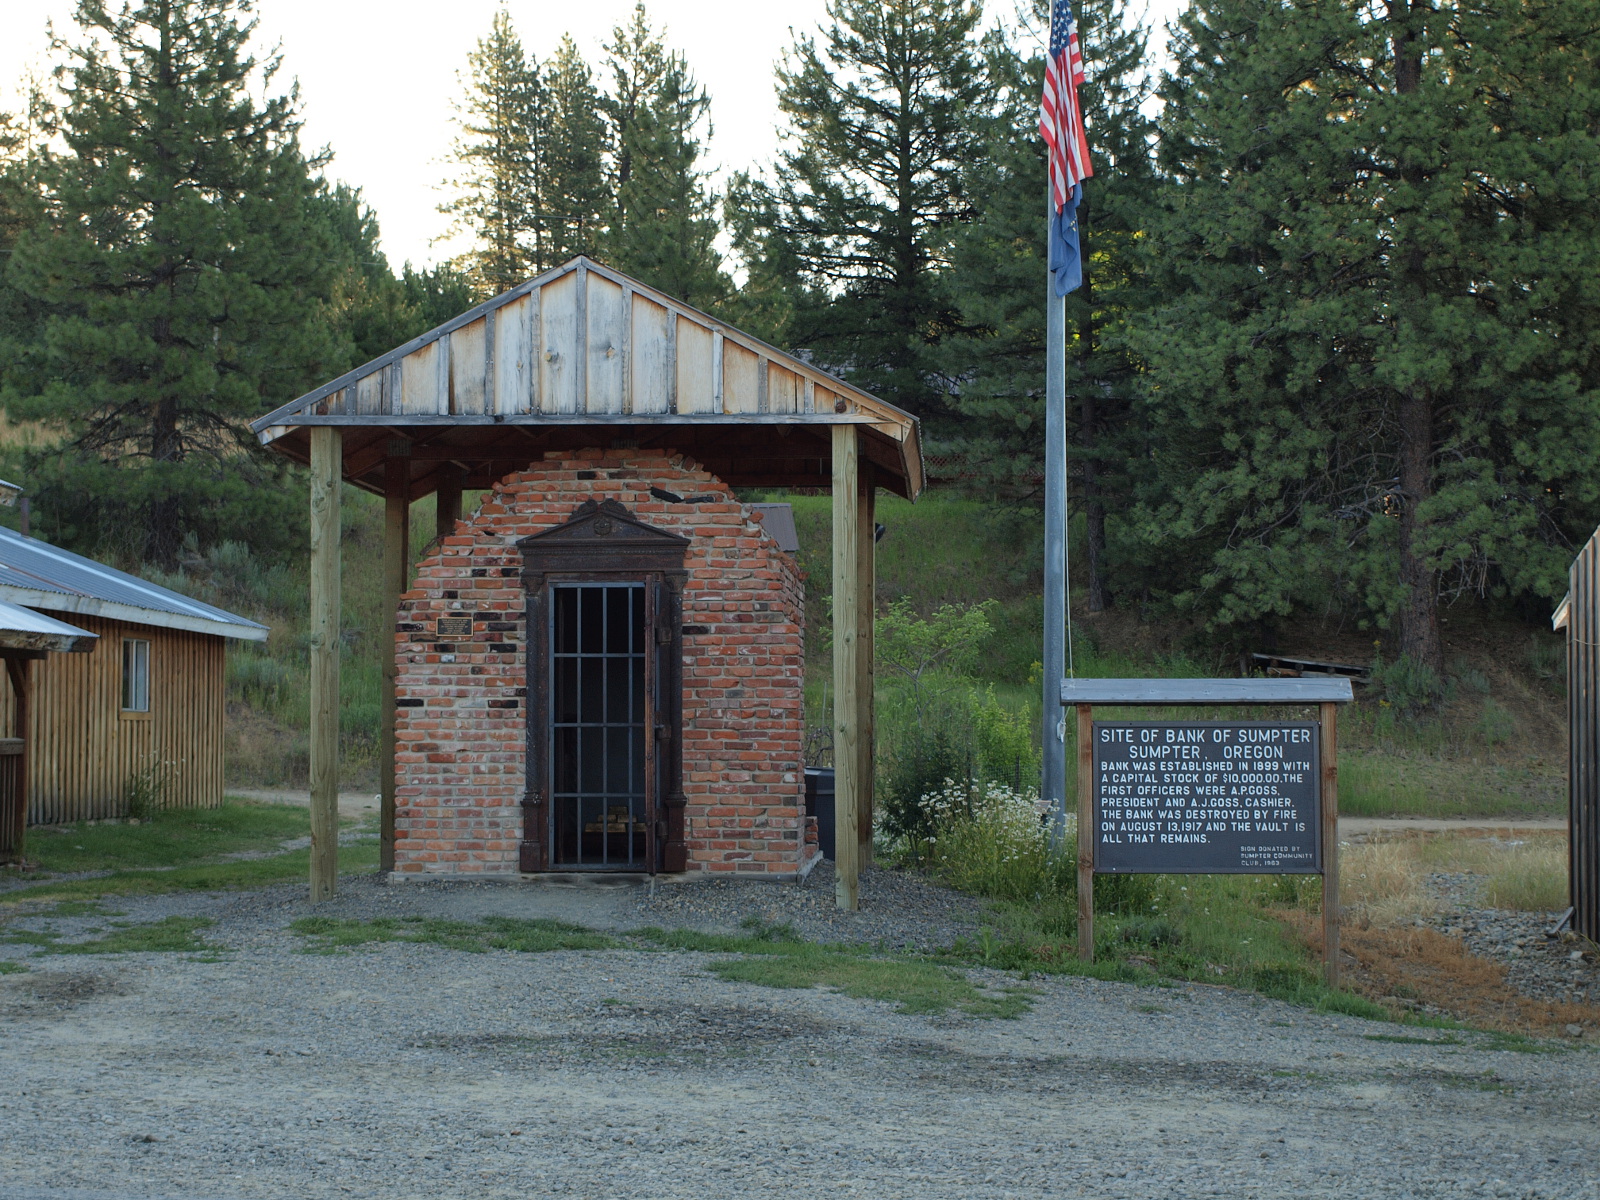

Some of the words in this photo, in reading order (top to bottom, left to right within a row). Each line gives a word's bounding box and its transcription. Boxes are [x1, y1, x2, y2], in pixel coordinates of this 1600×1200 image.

[1100, 728, 1135, 743] SITE
[1140, 728, 1160, 743] OF
[1165, 728, 1206, 743] BANK
[1212, 728, 1232, 743] OF
[1238, 728, 1311, 743] SUMPTER
[1223, 744, 1283, 758] OREGON
[1100, 760, 1130, 771] BANK
[1132, 760, 1156, 771] WAS
[1159, 760, 1234, 771] ESTABLISHED
[1238, 760, 1249, 771] IN
[1253, 760, 1279, 771] 1899
[1282, 760, 1310, 771] WITH
[1101, 772, 1109, 783] A
[1112, 772, 1159, 783] CAPITAL
[1163, 772, 1199, 783] STOCK
[1204, 772, 1219, 783] OF
[1101, 784, 1133, 795] FIRST
[1137, 784, 1191, 795] OFFICERS
[1195, 784, 1226, 795] WERE
[1101, 796, 1160, 807] PRESIDENT
[1165, 796, 1186, 807] AND
[1244, 796, 1295, 807] CASHIER.
[1101, 808, 1122, 819] THE
[1125, 808, 1154, 819] BANK
[1157, 808, 1182, 819] WAS
[1185, 808, 1250, 819] DESTROYED
[1253, 808, 1269, 819] BY
[1273, 808, 1298, 819] FIRE
[1101, 820, 1116, 831] ON
[1120, 820, 1163, 831] AUGUST
[1205, 820, 1227, 831] AND
[1230, 820, 1251, 831] THE
[1255, 820, 1289, 831] VAULT
[1295, 820, 1306, 831] IS
[1101, 832, 1123, 843] ALL
[1127, 832, 1156, 843] THAT
[1160, 832, 1211, 843] REMAINS.
